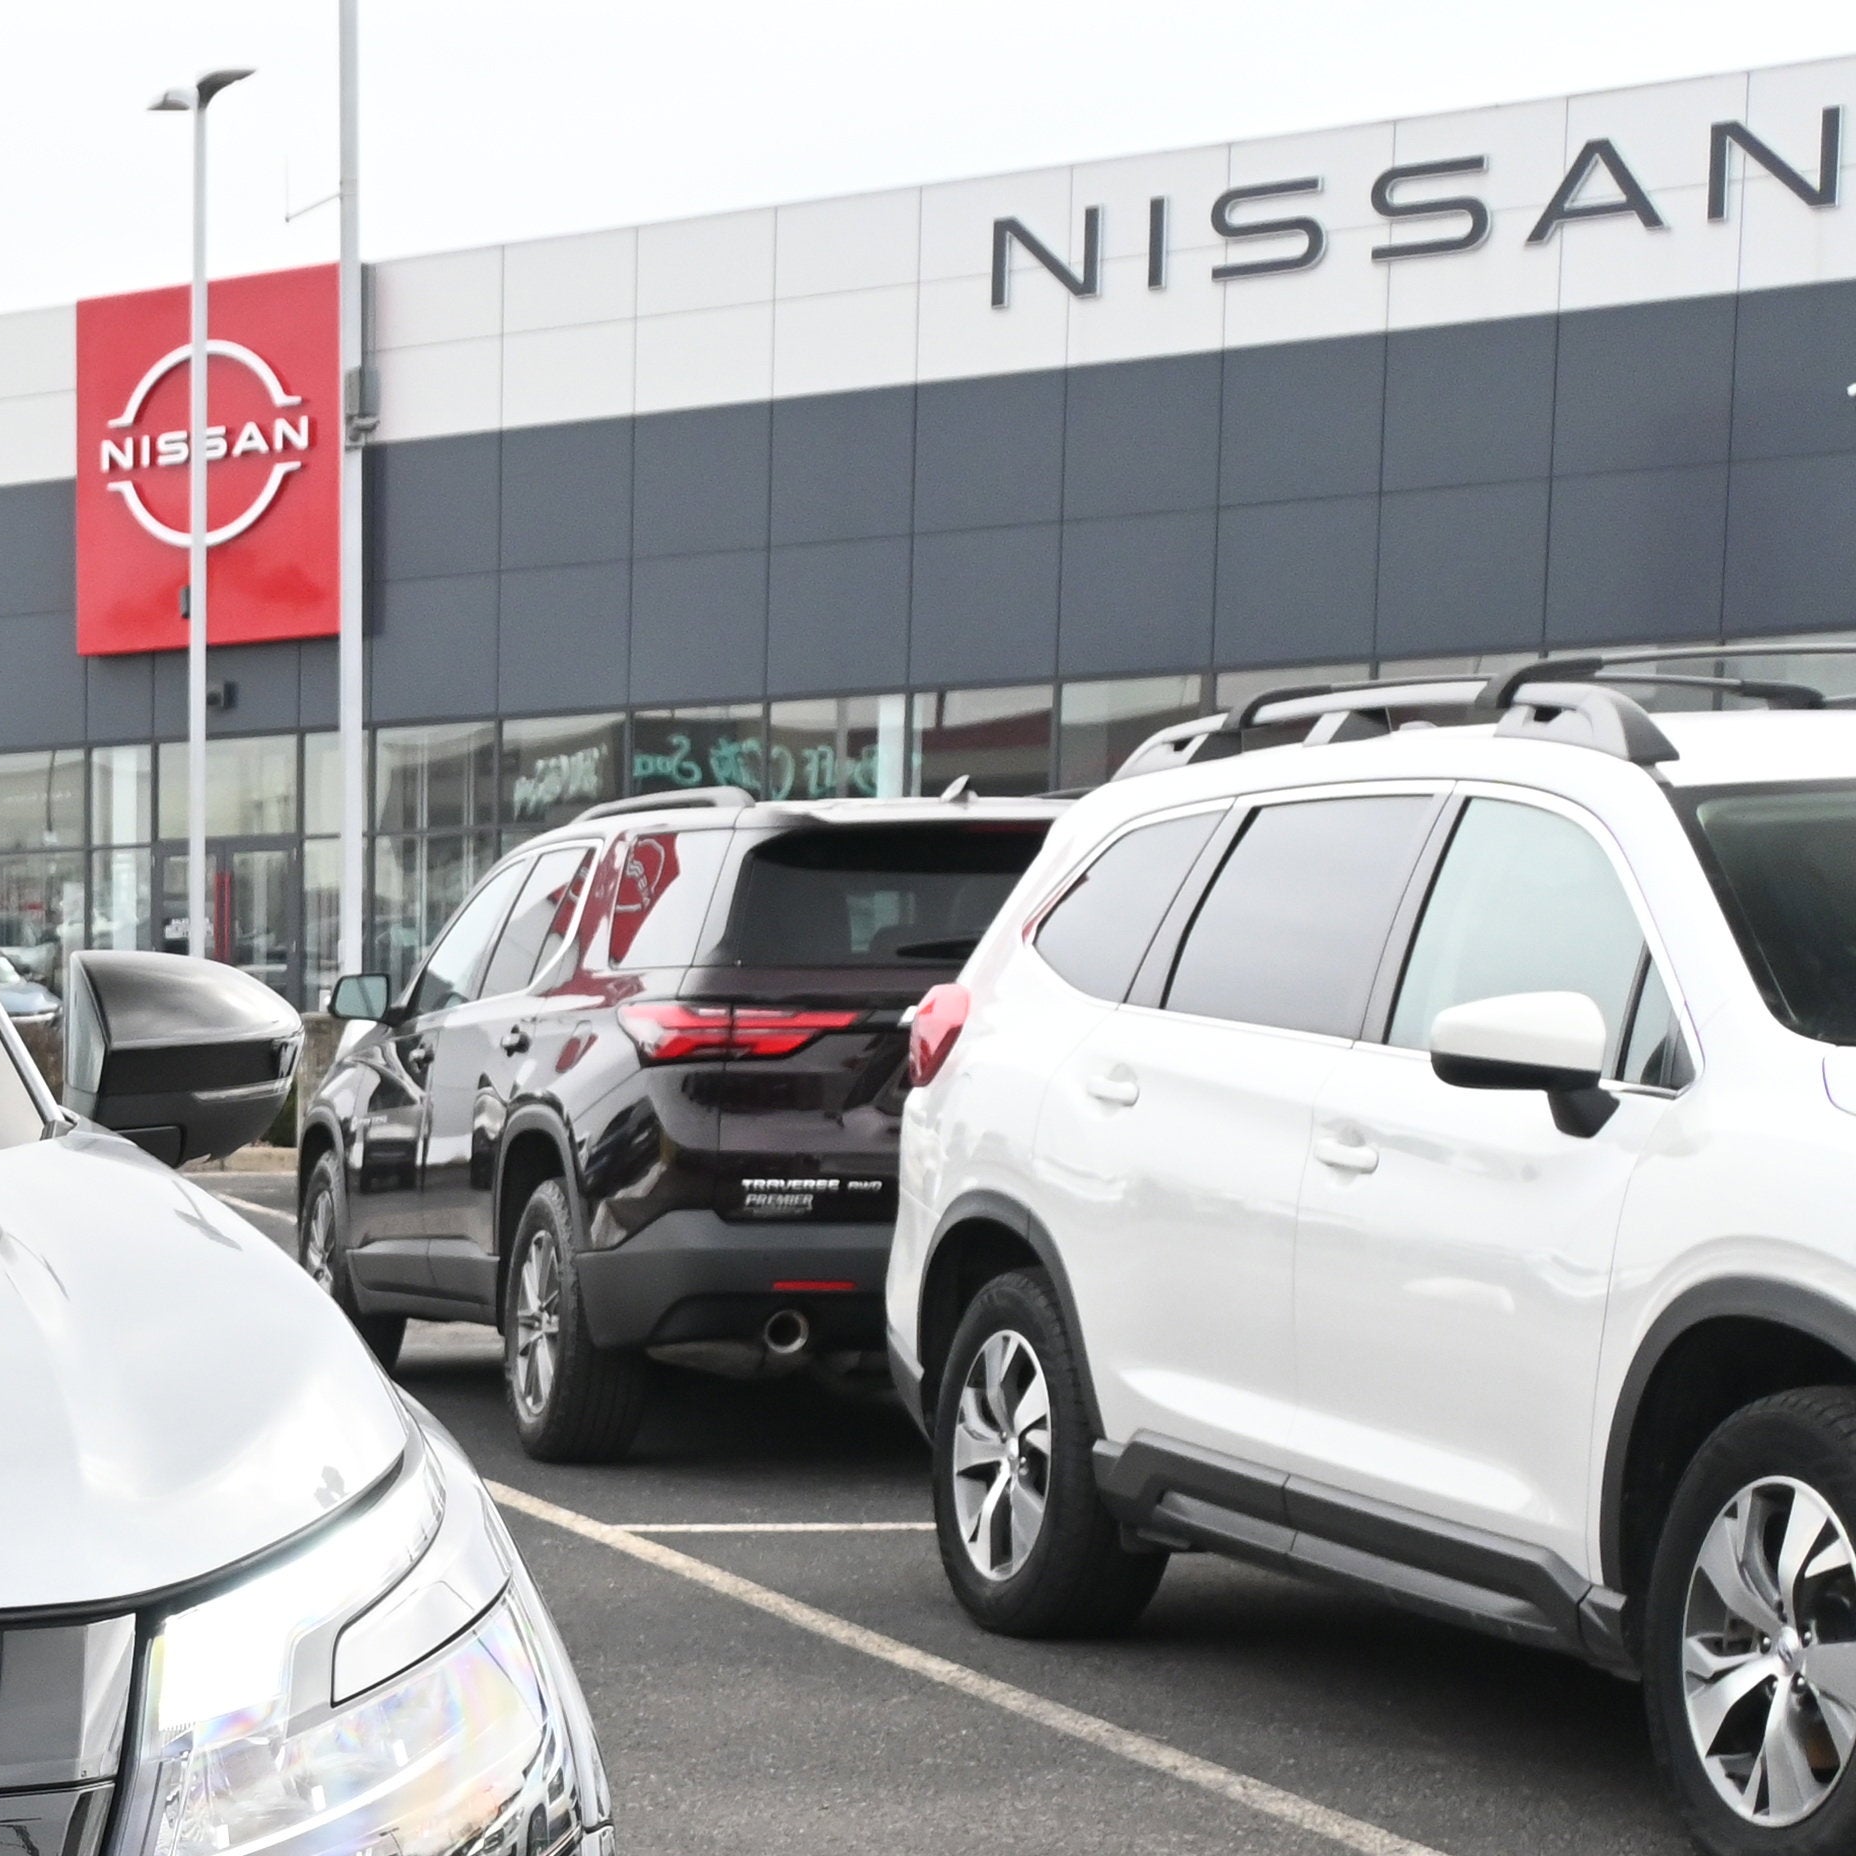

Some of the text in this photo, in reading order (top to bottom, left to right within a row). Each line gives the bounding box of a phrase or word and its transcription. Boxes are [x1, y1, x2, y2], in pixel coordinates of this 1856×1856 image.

[990, 104, 1846, 309] NISSAN
[100, 415, 309, 473] NISSAN
[741, 1178, 883, 1191] TRAVERSE AWD
[745, 1193, 814, 1207] PREMIER
